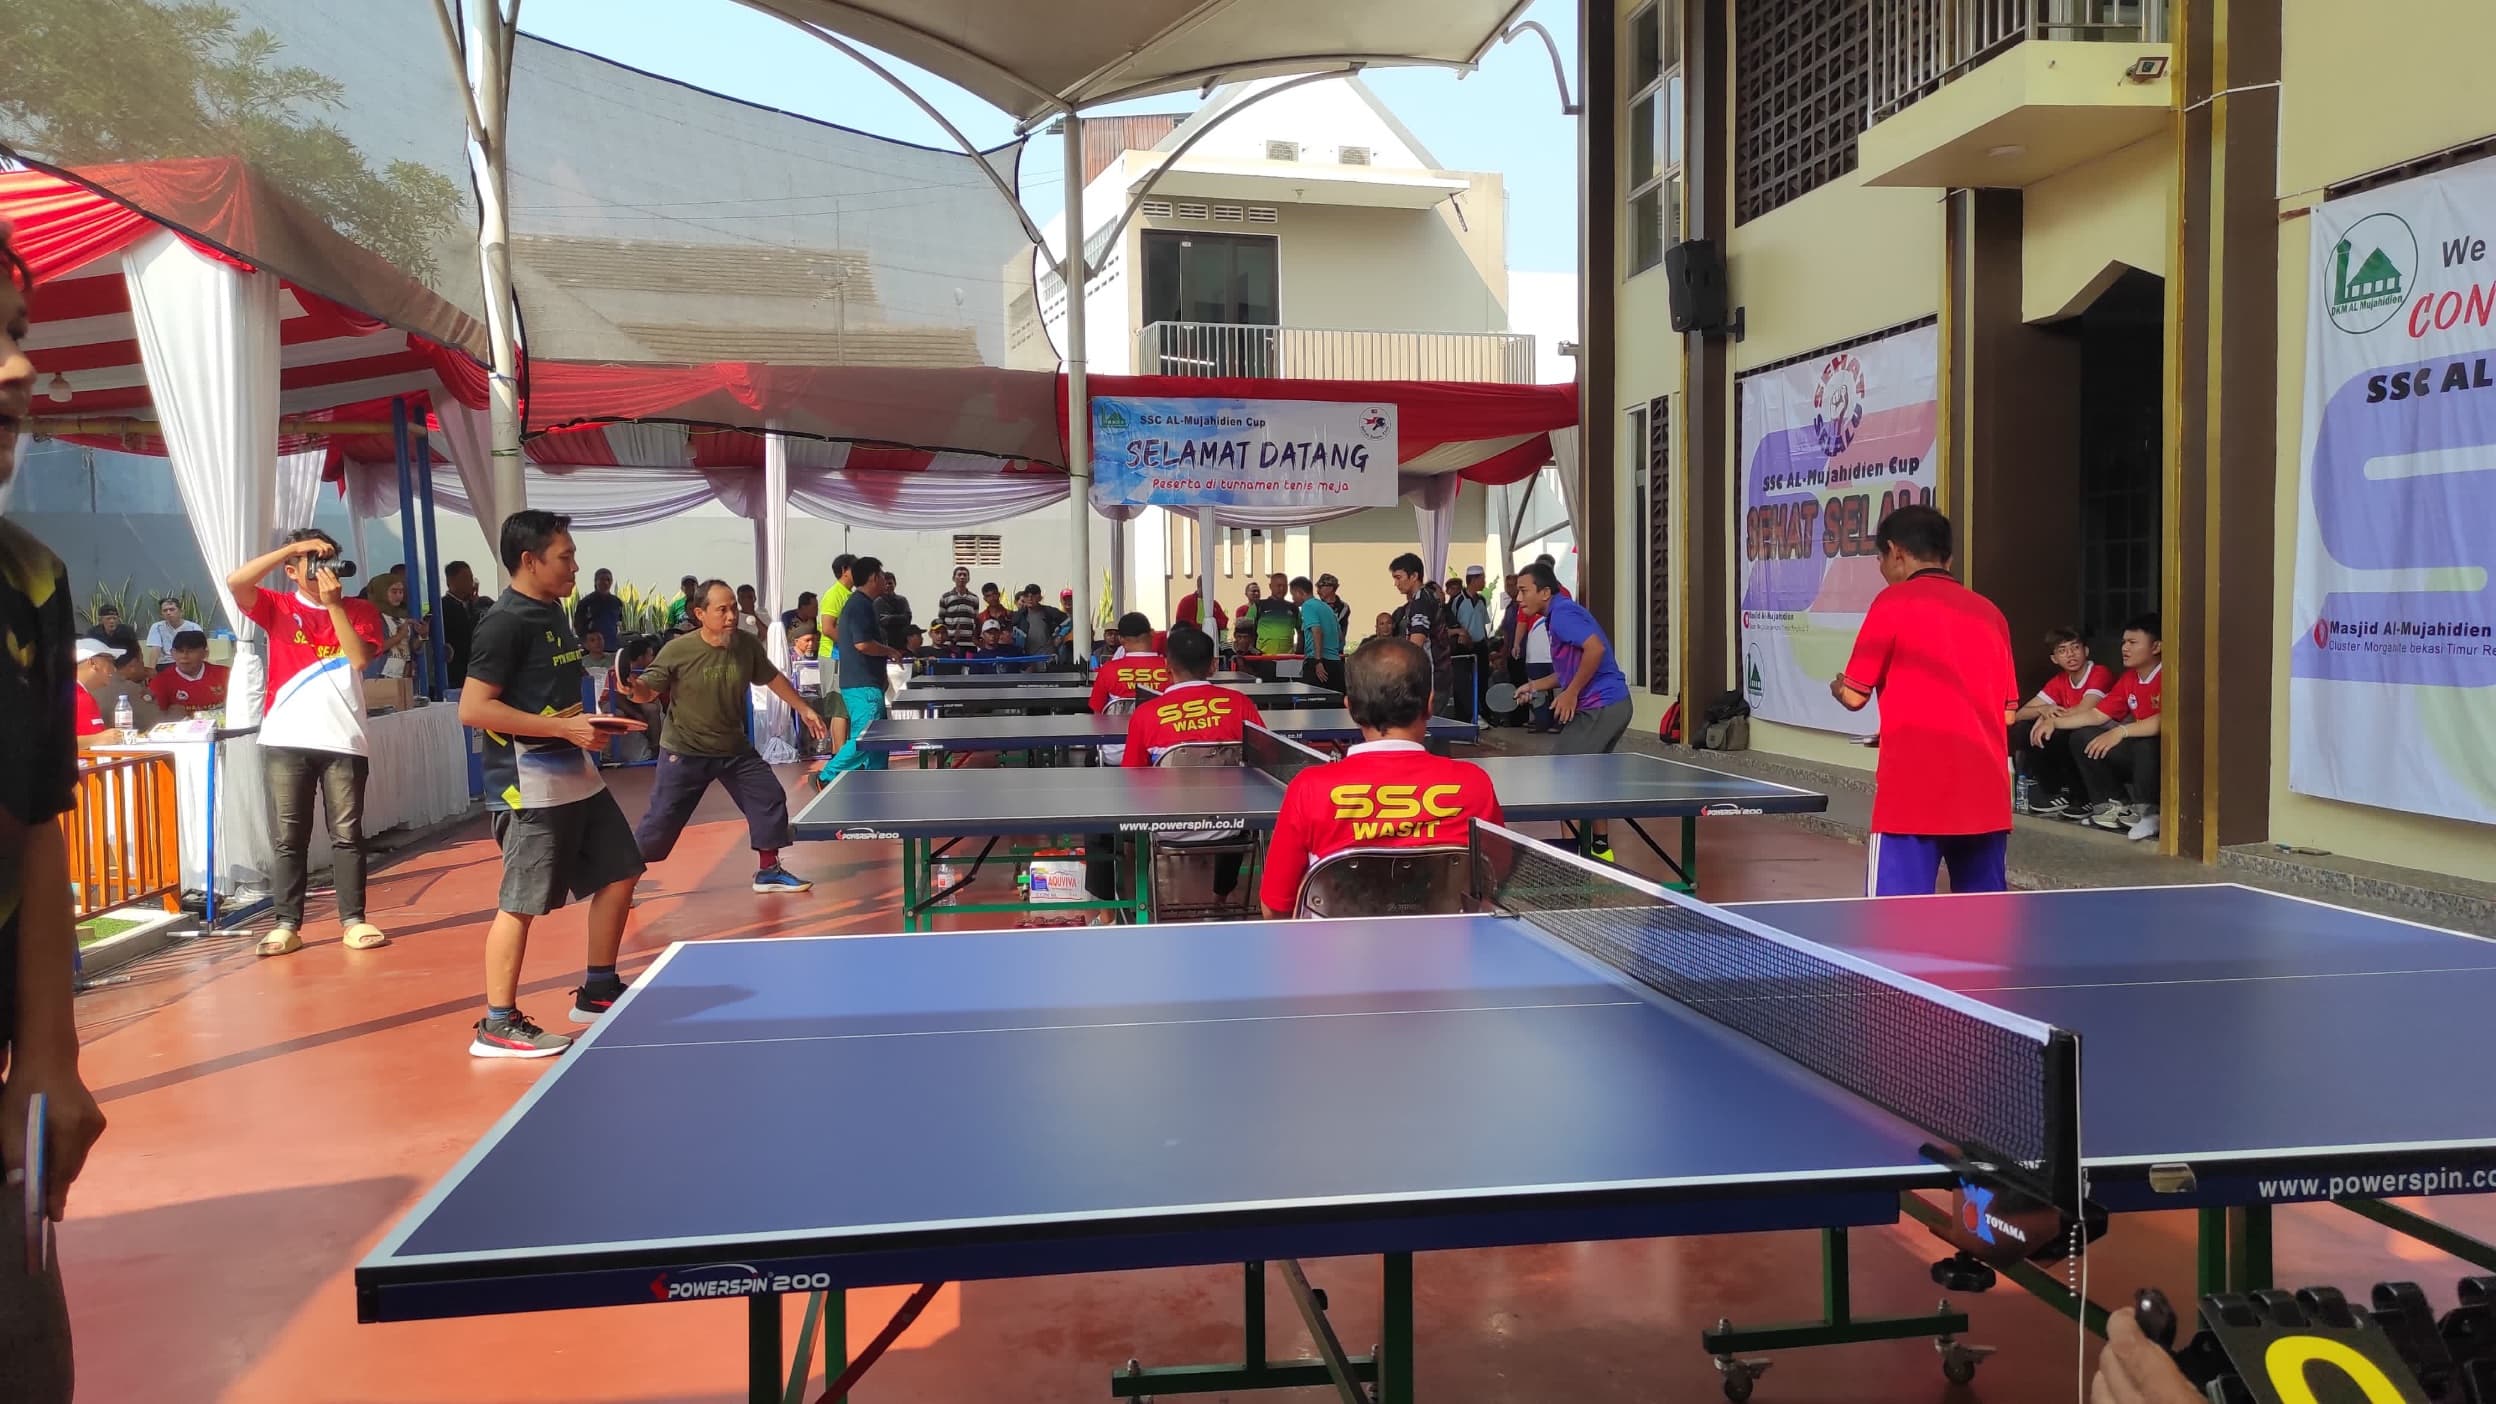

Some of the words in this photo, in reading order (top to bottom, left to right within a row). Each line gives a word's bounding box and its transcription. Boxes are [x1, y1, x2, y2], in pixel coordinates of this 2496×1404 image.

[2442, 235, 2486, 268] We
[2331, 305, 2347, 316] DKM
[2348, 303, 2358, 312] AL
[1814, 353, 1865, 408] SEHAT
[2366, 367, 2432, 403] SSC
[1140, 415, 1162, 425] SSC
[1166, 416, 1242, 427] AL-Mujahidien
[1246, 417, 1266, 429] Cup
[1814, 403, 1863, 457] SELALU
[1126, 439, 1251, 471] SELAMAT
[1259, 441, 1370, 473] DATANG
[1152, 478, 1201, 490] Peserta
[1206, 479, 1216, 489] di
[1220, 480, 1279, 491] turnamen
[1284, 480, 1313, 491] tenis
[1319, 481, 1350, 493] meja
[1763, 475, 1783, 492] SSC
[1786, 462, 1884, 489] AL-Mujahidien
[1888, 455, 1920, 475] Cup
[1746, 499, 1819, 562] SEHAT
[2329, 621, 2378, 638] Masjid
[2383, 622, 2491, 639] Al-Mujahidien
[2329, 640, 2360, 651] Cluster
[2410, 643, 2443, 654] bekasi
[2447, 643, 2477, 656] Timur
[1117, 668, 1168, 682] SSC
[1127, 682, 1160, 690] WSIT
[1157, 697, 1232, 725] SSC
[1173, 716, 1221, 732] WASIT
[1330, 784, 1463, 819] SSC
[1119, 818, 1245, 832] www.powerspin.co.id
[1353, 820, 1440, 840] WASIT
[1985, 1213, 2026, 1243] TOYAMA
[668, 1277, 768, 1298] POWERSPIN
[772, 1273, 830, 1291] 200
